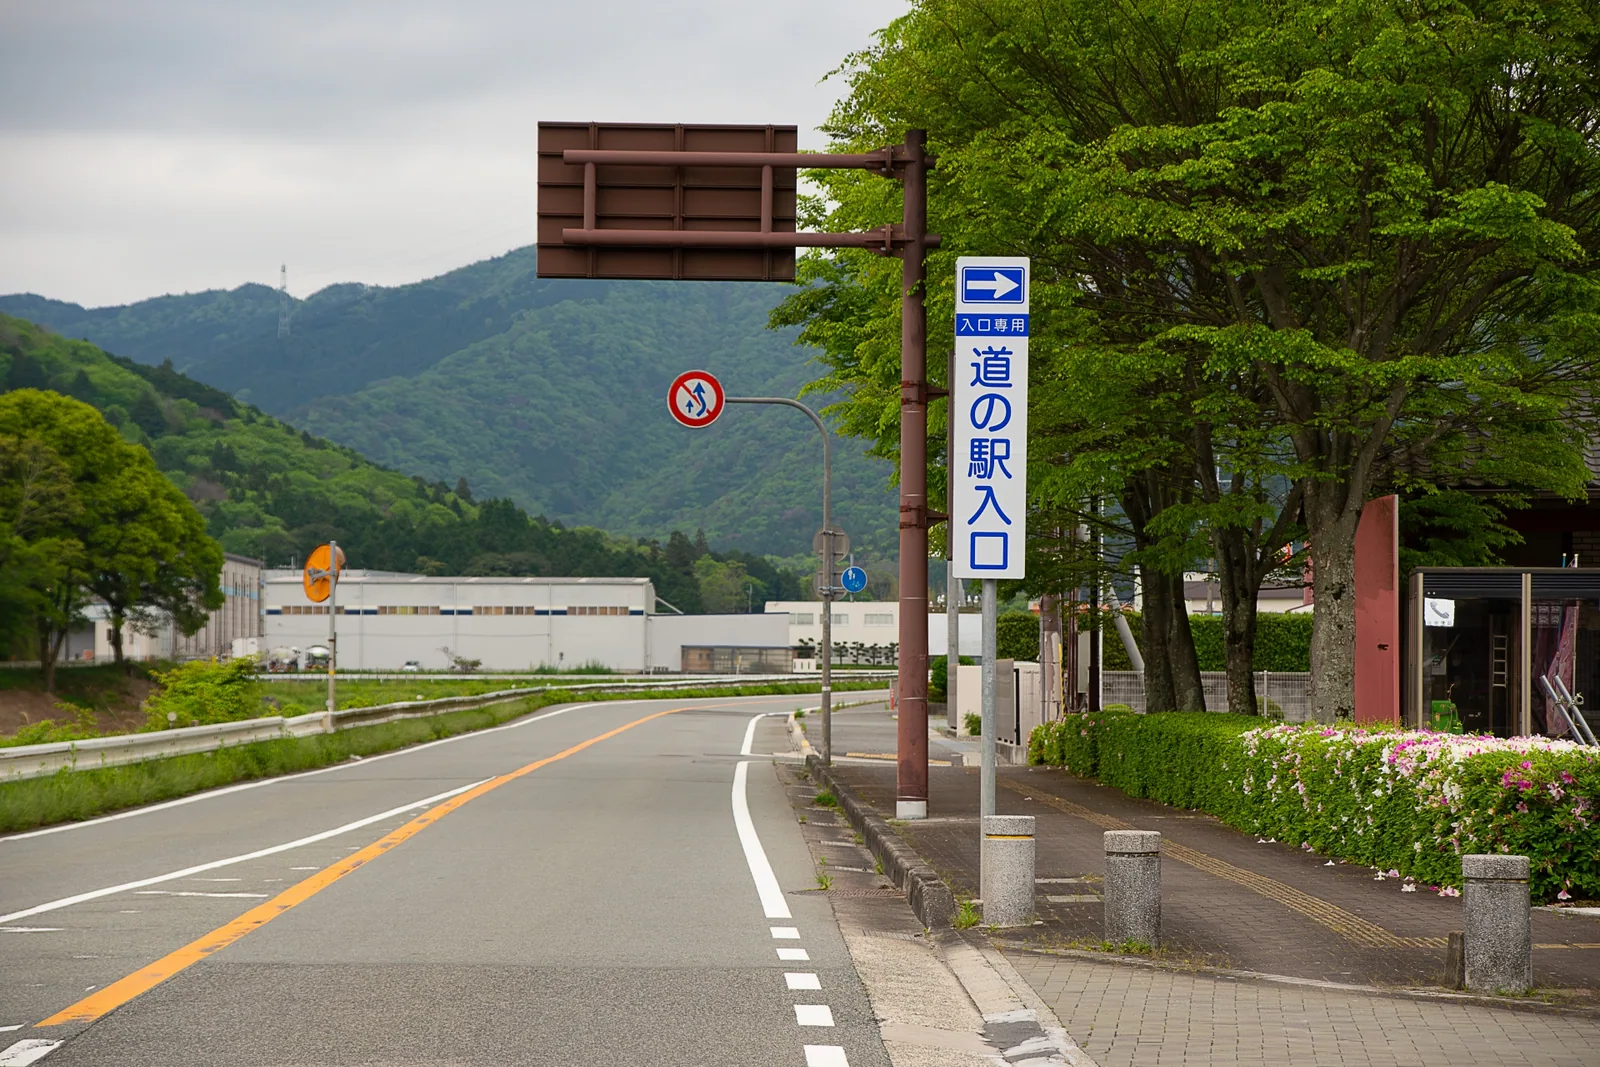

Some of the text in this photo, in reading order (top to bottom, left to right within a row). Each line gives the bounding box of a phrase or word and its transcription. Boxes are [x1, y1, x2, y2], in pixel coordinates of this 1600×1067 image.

[960, 318, 1024, 333] 入口専用
[967, 345, 1013, 570] 道の駅入口
